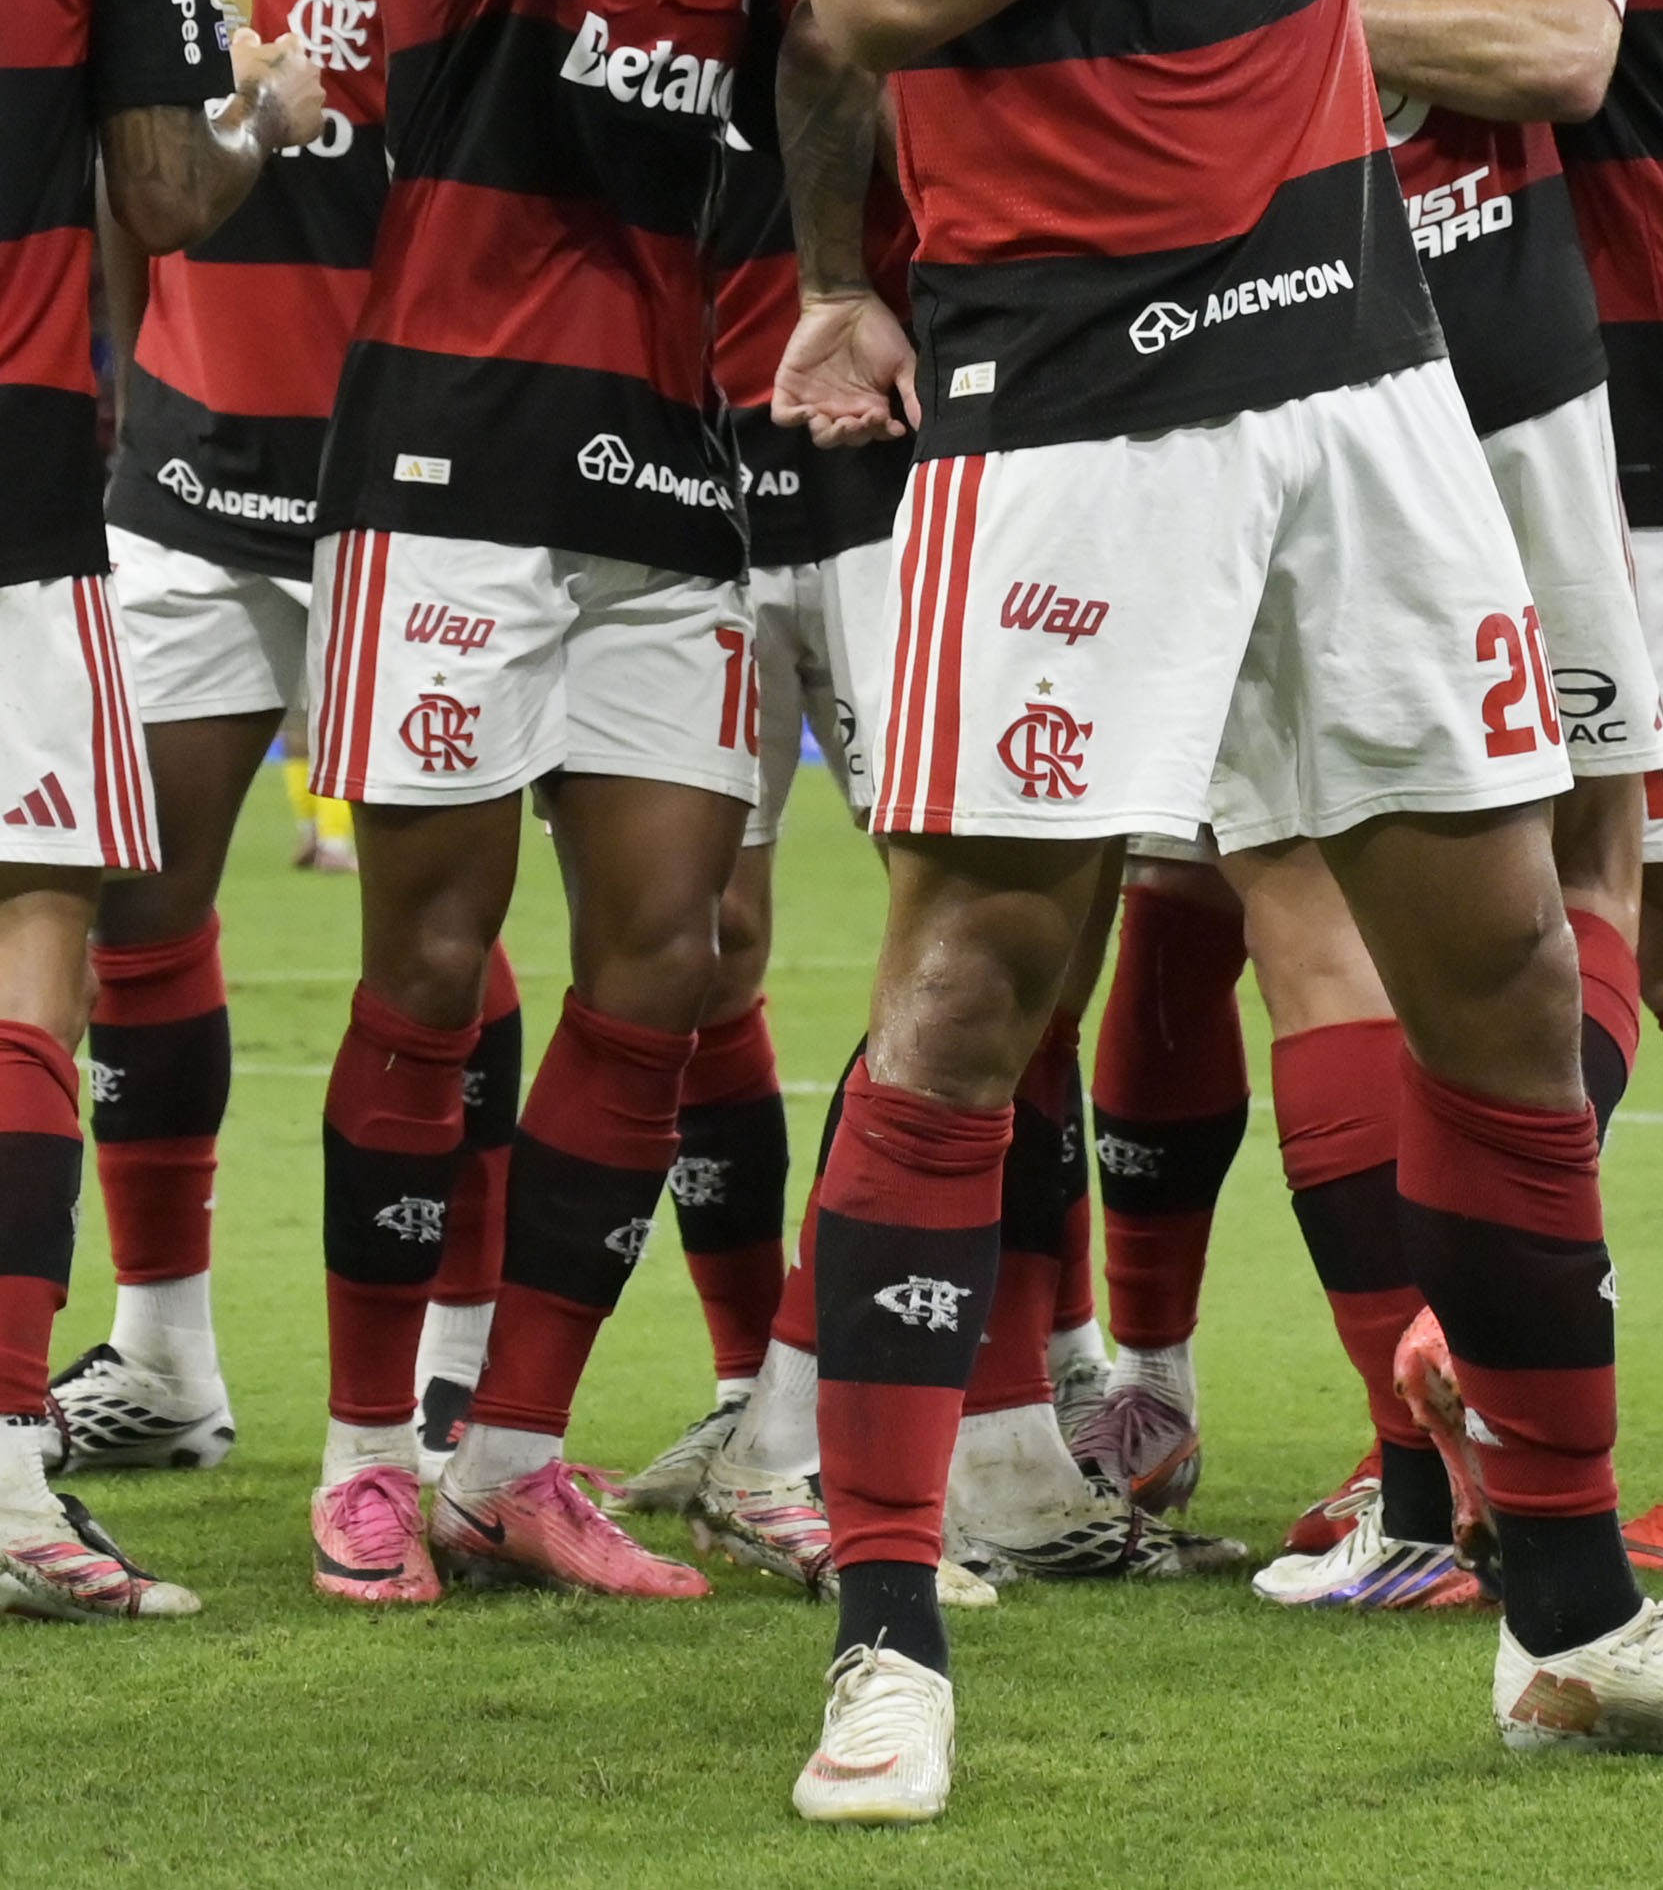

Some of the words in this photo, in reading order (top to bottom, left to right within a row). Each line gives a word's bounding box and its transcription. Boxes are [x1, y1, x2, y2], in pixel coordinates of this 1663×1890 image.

[1203, 258, 1355, 328] ADEMICON
[404, 601, 496, 656] Wap
[1000, 580, 1110, 646] Wap
[1567, 720, 1628, 745] AC
